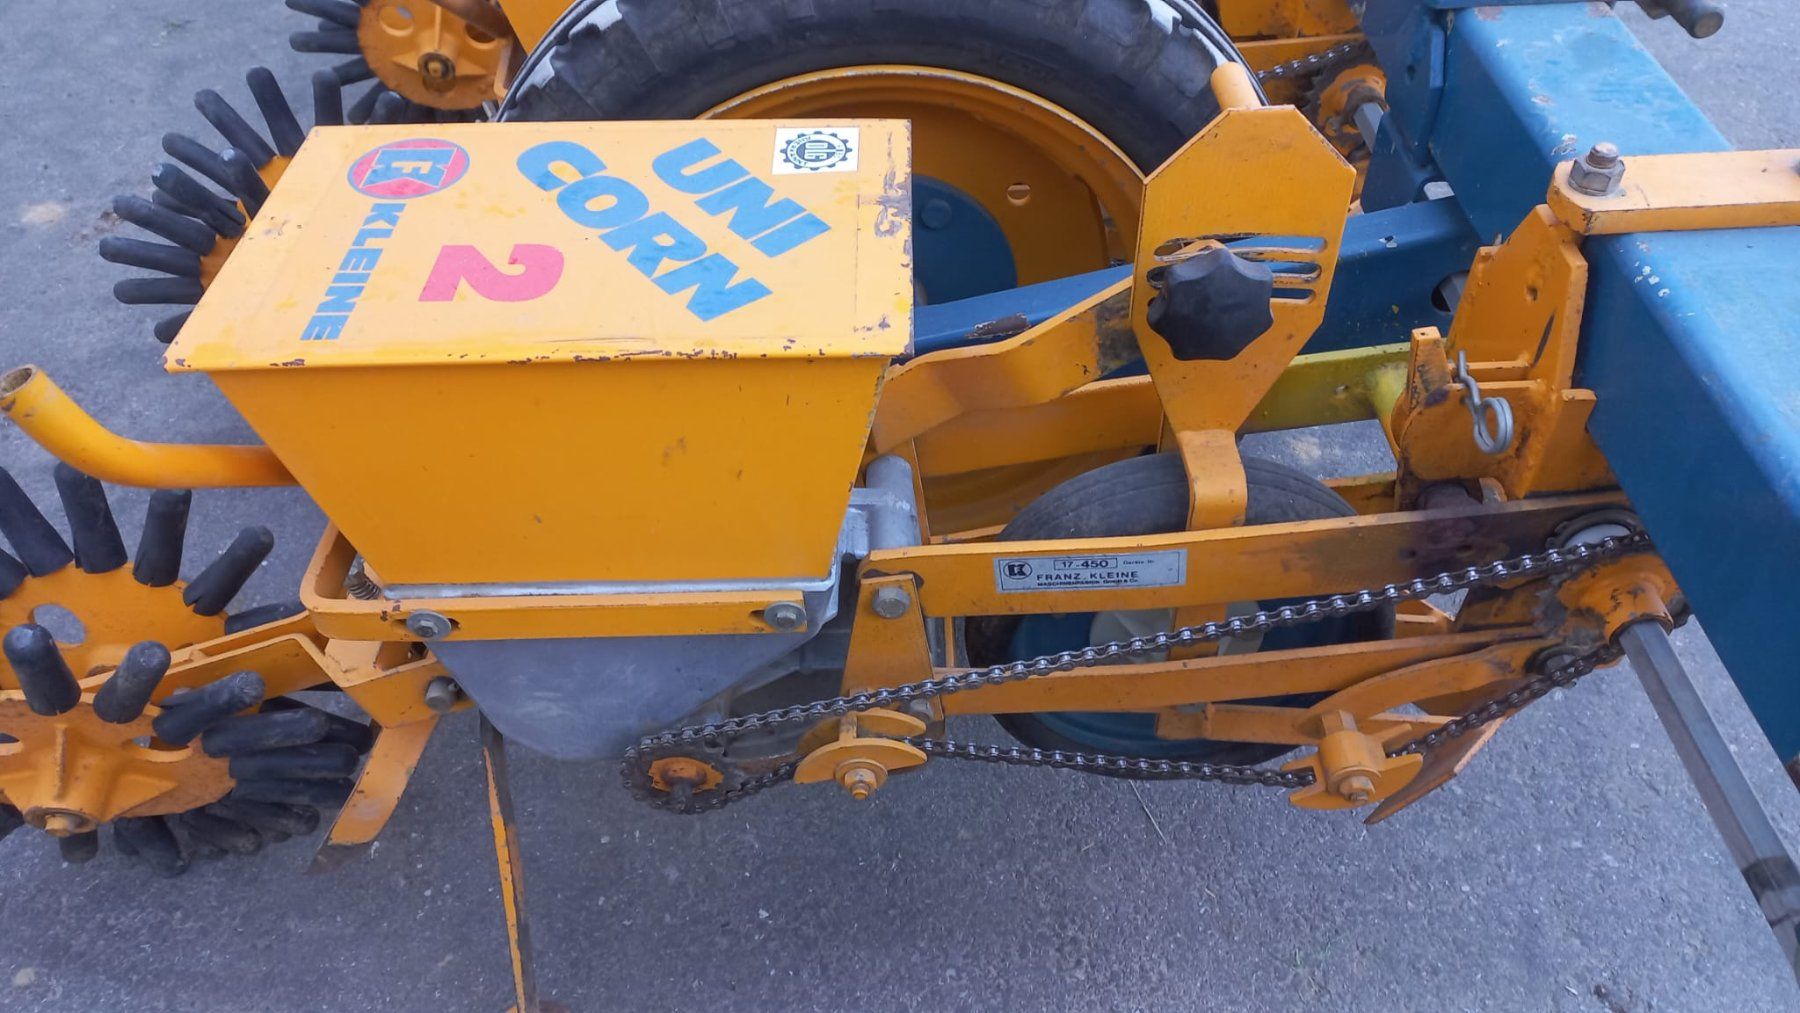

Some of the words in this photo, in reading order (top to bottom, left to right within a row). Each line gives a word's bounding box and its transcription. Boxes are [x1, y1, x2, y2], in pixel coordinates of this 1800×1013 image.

[516, 140, 774, 322] CORN
[652, 137, 832, 258] UNI
[299, 202, 407, 341] KLEINE
[418, 243, 565, 302] 2
[1036, 573, 1081, 581] FRANZ
[1090, 571, 1139, 579] KLEINE
